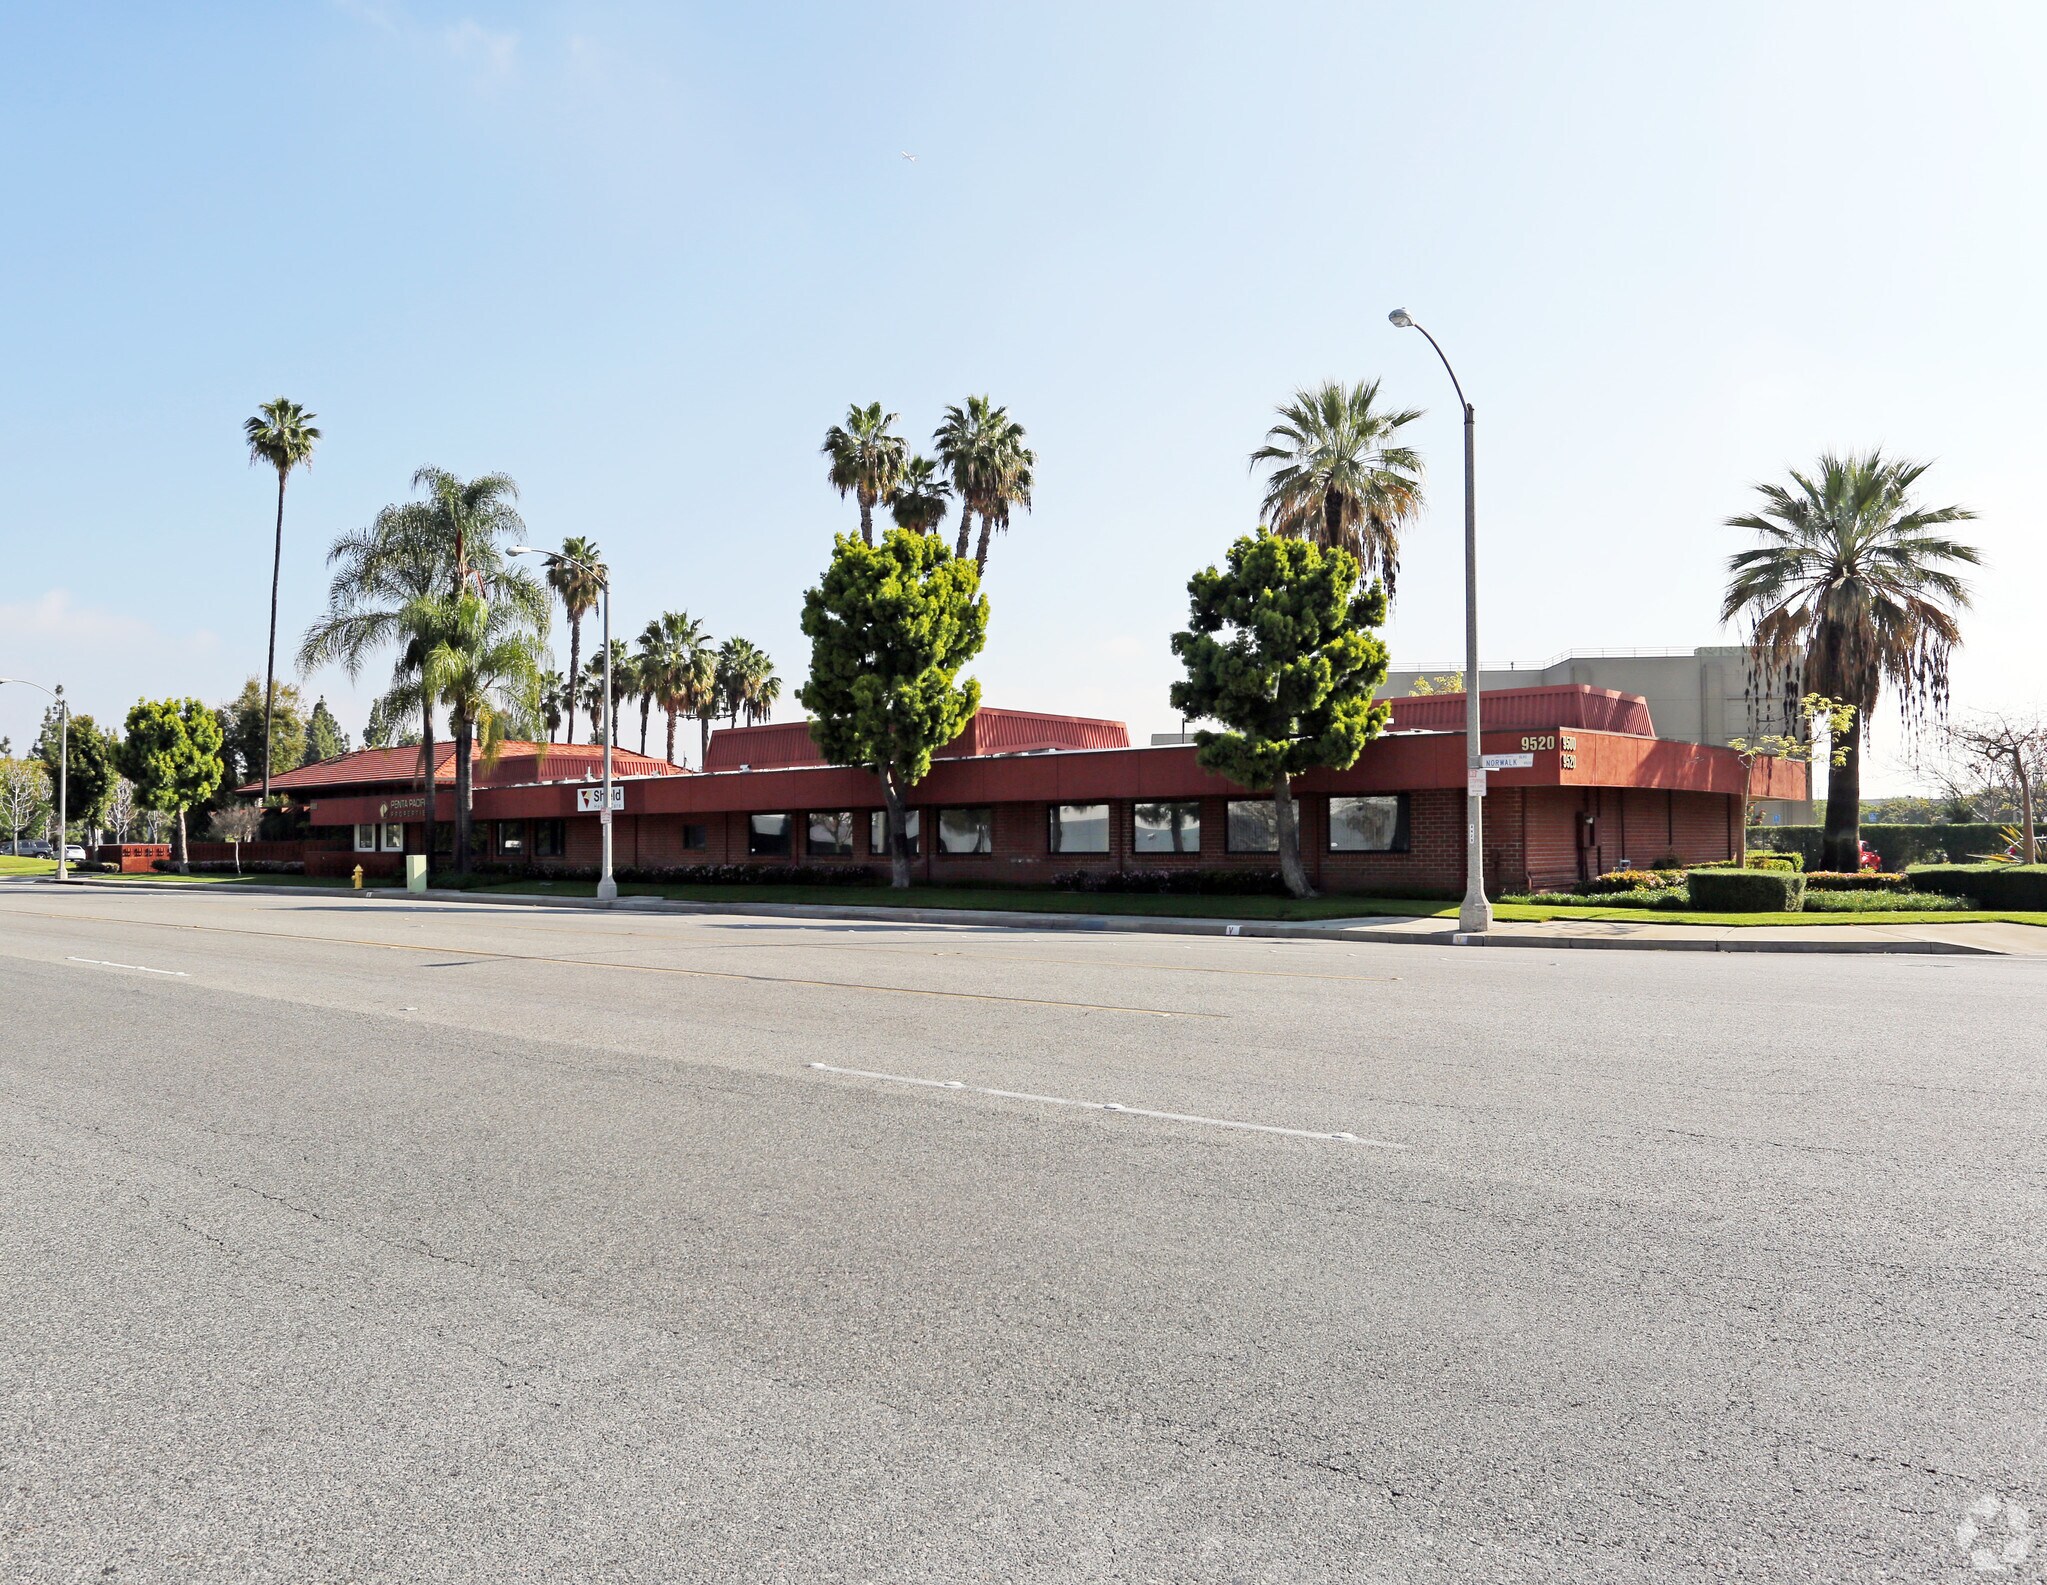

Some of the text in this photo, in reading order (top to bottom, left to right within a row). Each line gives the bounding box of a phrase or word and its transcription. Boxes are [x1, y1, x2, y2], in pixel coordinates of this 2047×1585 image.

[1521, 736, 1555, 751] 9520
[1486, 759, 1518, 767] NORWALK
[1562, 754, 1577, 770] 9520
[593, 789, 621, 802] Shld
[390, 799, 408, 808] PENTA
[390, 809, 426, 817] PROPERTIE
